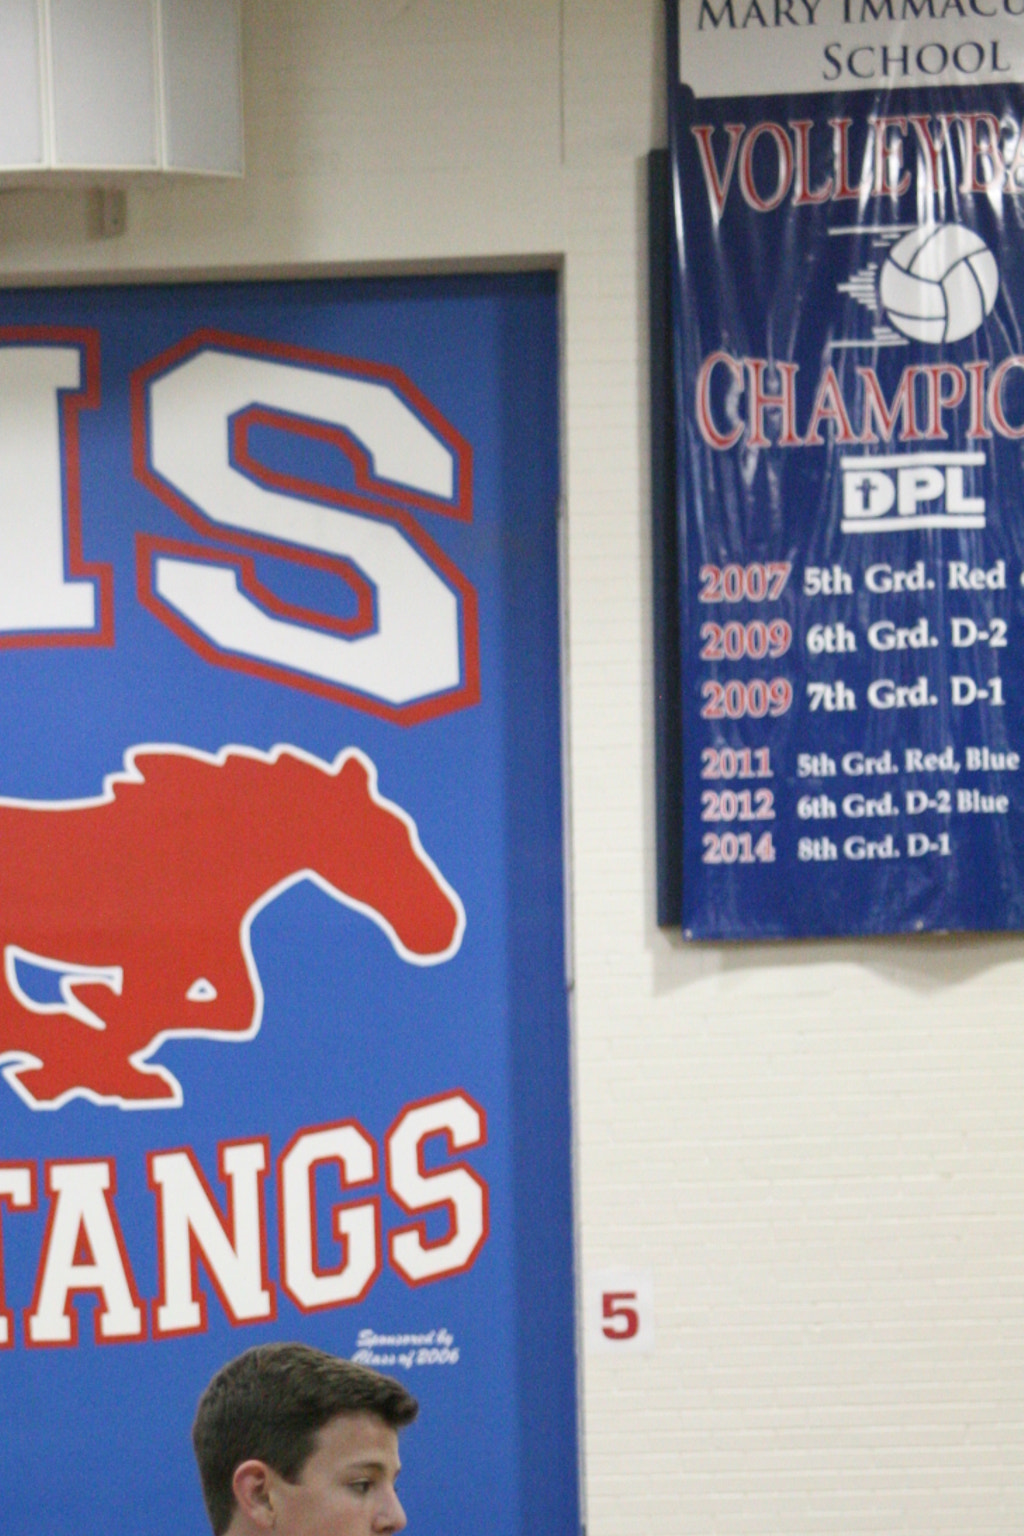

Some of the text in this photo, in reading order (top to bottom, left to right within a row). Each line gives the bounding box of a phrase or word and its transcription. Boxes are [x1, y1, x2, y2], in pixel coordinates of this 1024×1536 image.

[697, 0, 821, 31] MARY
[822, 40, 1012, 81] SCHOOL
[842, 465, 986, 518] DPL
[699, 562, 792, 603] 2007
[804, 566, 853, 595] 5th
[864, 562, 936, 593] Grd.
[948, 560, 1006, 589] Red
[700, 618, 1008, 660] 2009 6th Grd. D-2
[701, 676, 1006, 719] 2009 7th Grd. D-1
[701, 747, 1020, 779] 2011 5th Grd. Red, Blue
[701, 789, 1009, 822] 2012 6th Grd. D-2 Blue
[702, 831, 952, 863] 2014 8th Grd. D-1
[601, 1291, 639, 1341] 5
[356, 1327, 454, 1348] Sponsored by
[397, 1349, 415, 1369] of
[416, 1347, 460, 1365] 2006
